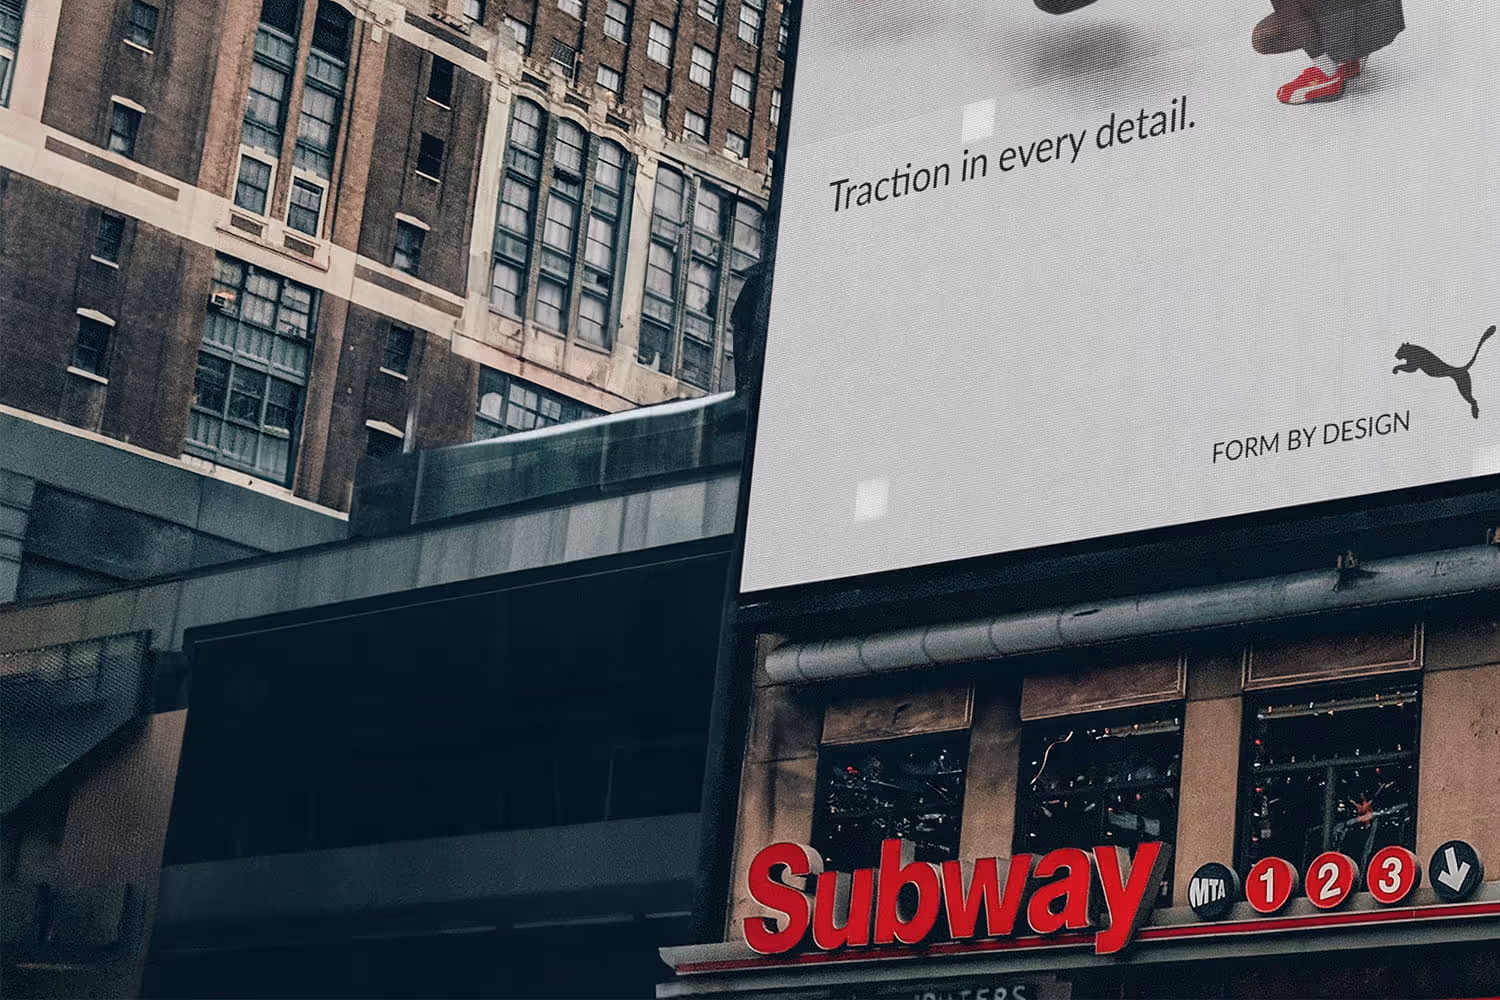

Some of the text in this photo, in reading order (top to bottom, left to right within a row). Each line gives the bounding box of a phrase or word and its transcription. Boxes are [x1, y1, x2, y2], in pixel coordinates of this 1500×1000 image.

[829, 95, 1196, 212] Traction in every detail.
[1213, 410, 1411, 464] FORM BY DESIGN
[743, 838, 1404, 956] Subway MTA 1 2 3
